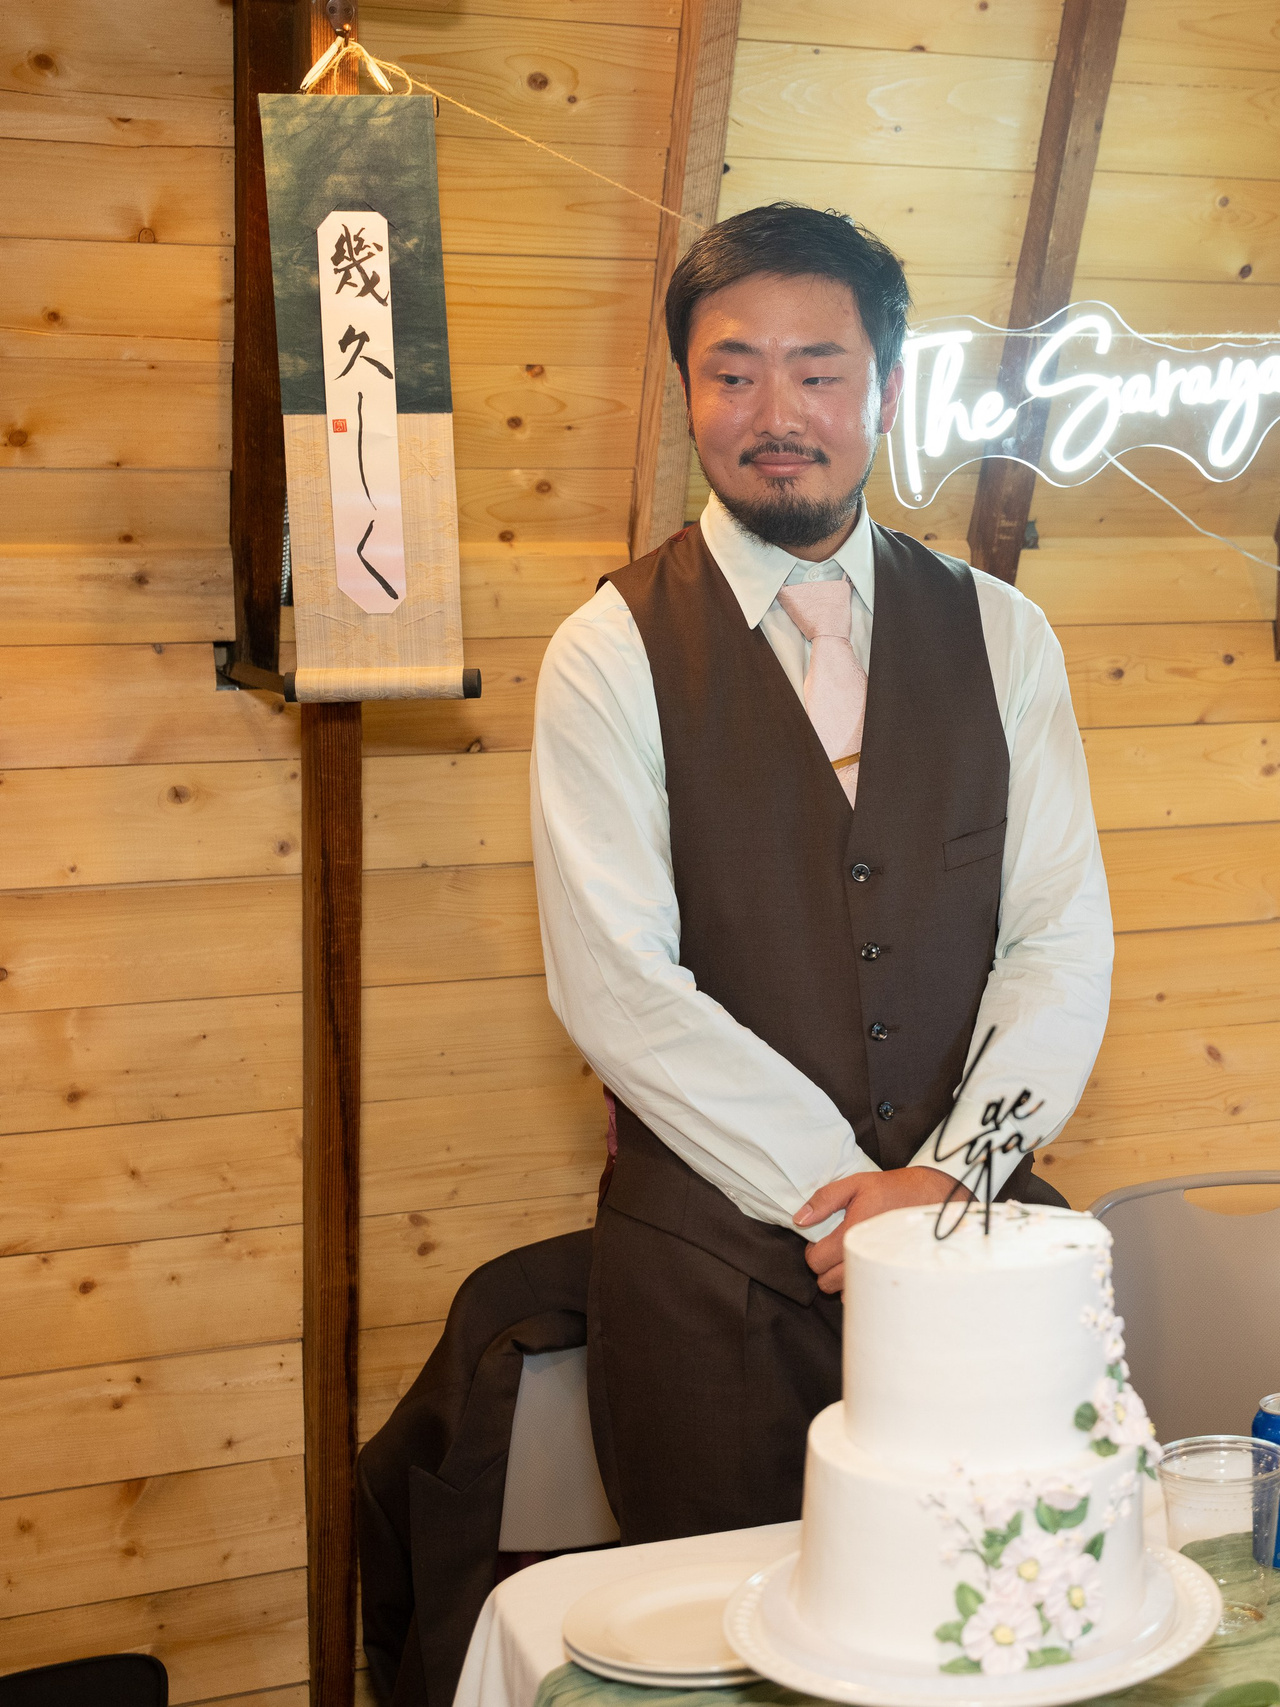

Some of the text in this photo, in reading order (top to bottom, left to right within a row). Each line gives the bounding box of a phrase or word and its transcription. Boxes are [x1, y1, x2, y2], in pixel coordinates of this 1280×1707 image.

[330, 223, 399, 601] 幾久しく
[901, 330, 1017, 494] The
